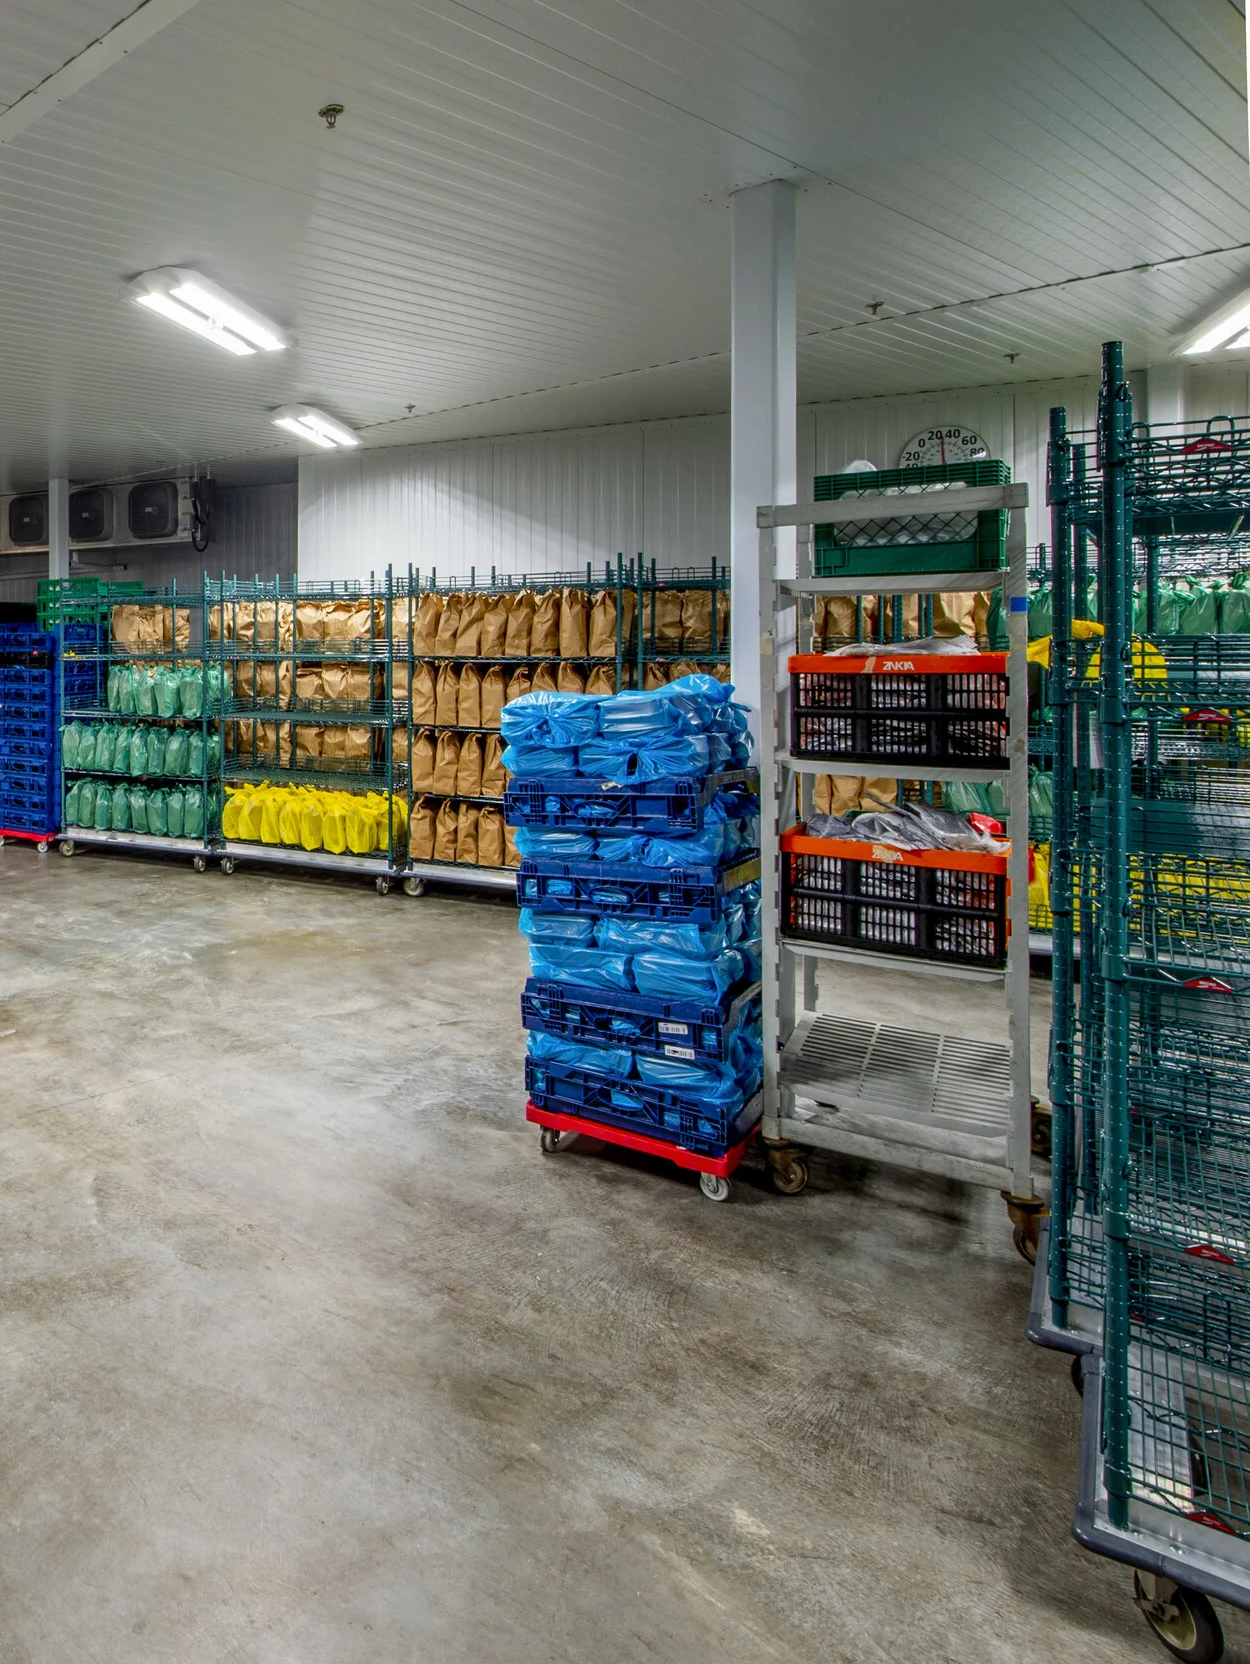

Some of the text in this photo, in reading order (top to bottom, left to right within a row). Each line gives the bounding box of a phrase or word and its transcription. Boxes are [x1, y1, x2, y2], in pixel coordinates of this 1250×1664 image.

[928, 430, 943, 440] 20
[945, 429, 961, 439] 40
[918, 439, 926, 448] 0
[961, 435, 977, 445] 60
[902, 451, 920, 461] -20
